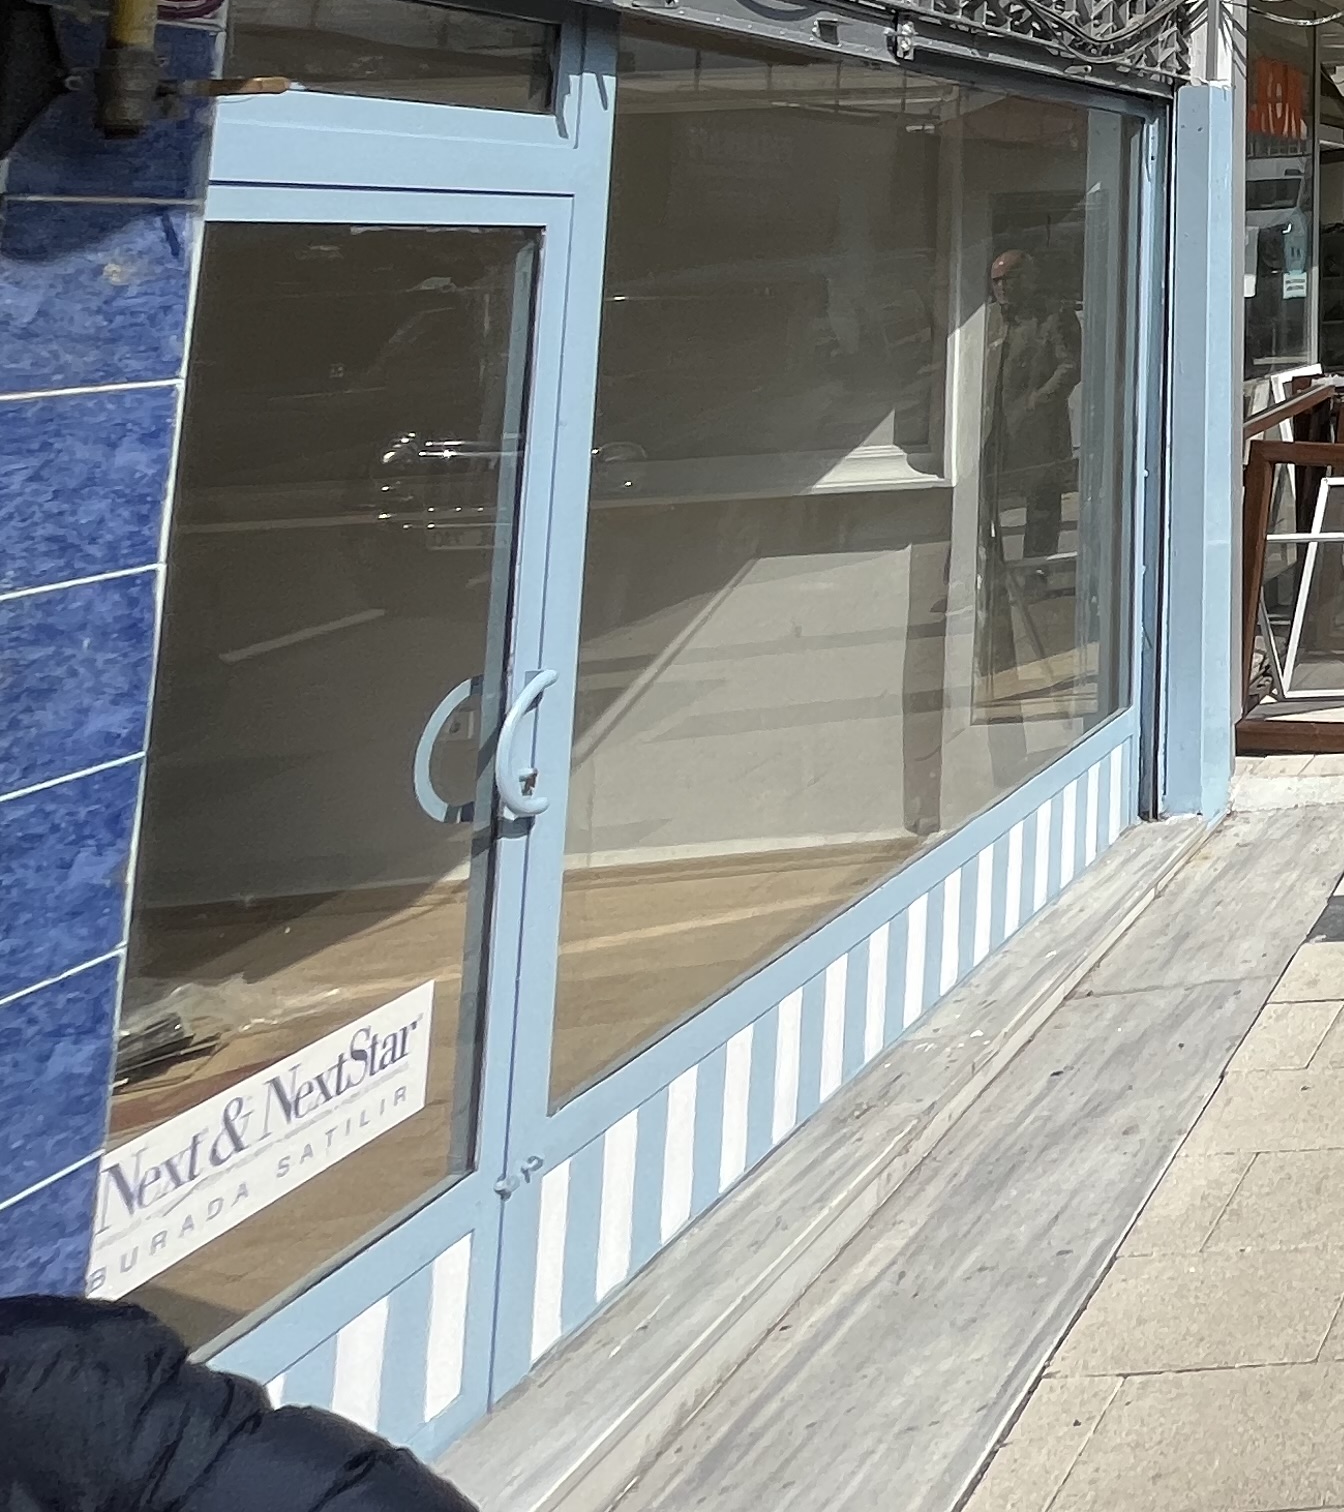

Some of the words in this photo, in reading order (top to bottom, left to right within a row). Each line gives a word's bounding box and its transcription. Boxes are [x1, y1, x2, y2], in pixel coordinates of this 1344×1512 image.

[86, 1182, 249, 1291] BURADA
[276, 1085, 408, 1178] SATILIR
[93, 1128, 208, 1235] Next
[208, 1096, 255, 1167] &
[257, 1021, 419, 1142] NextStar
